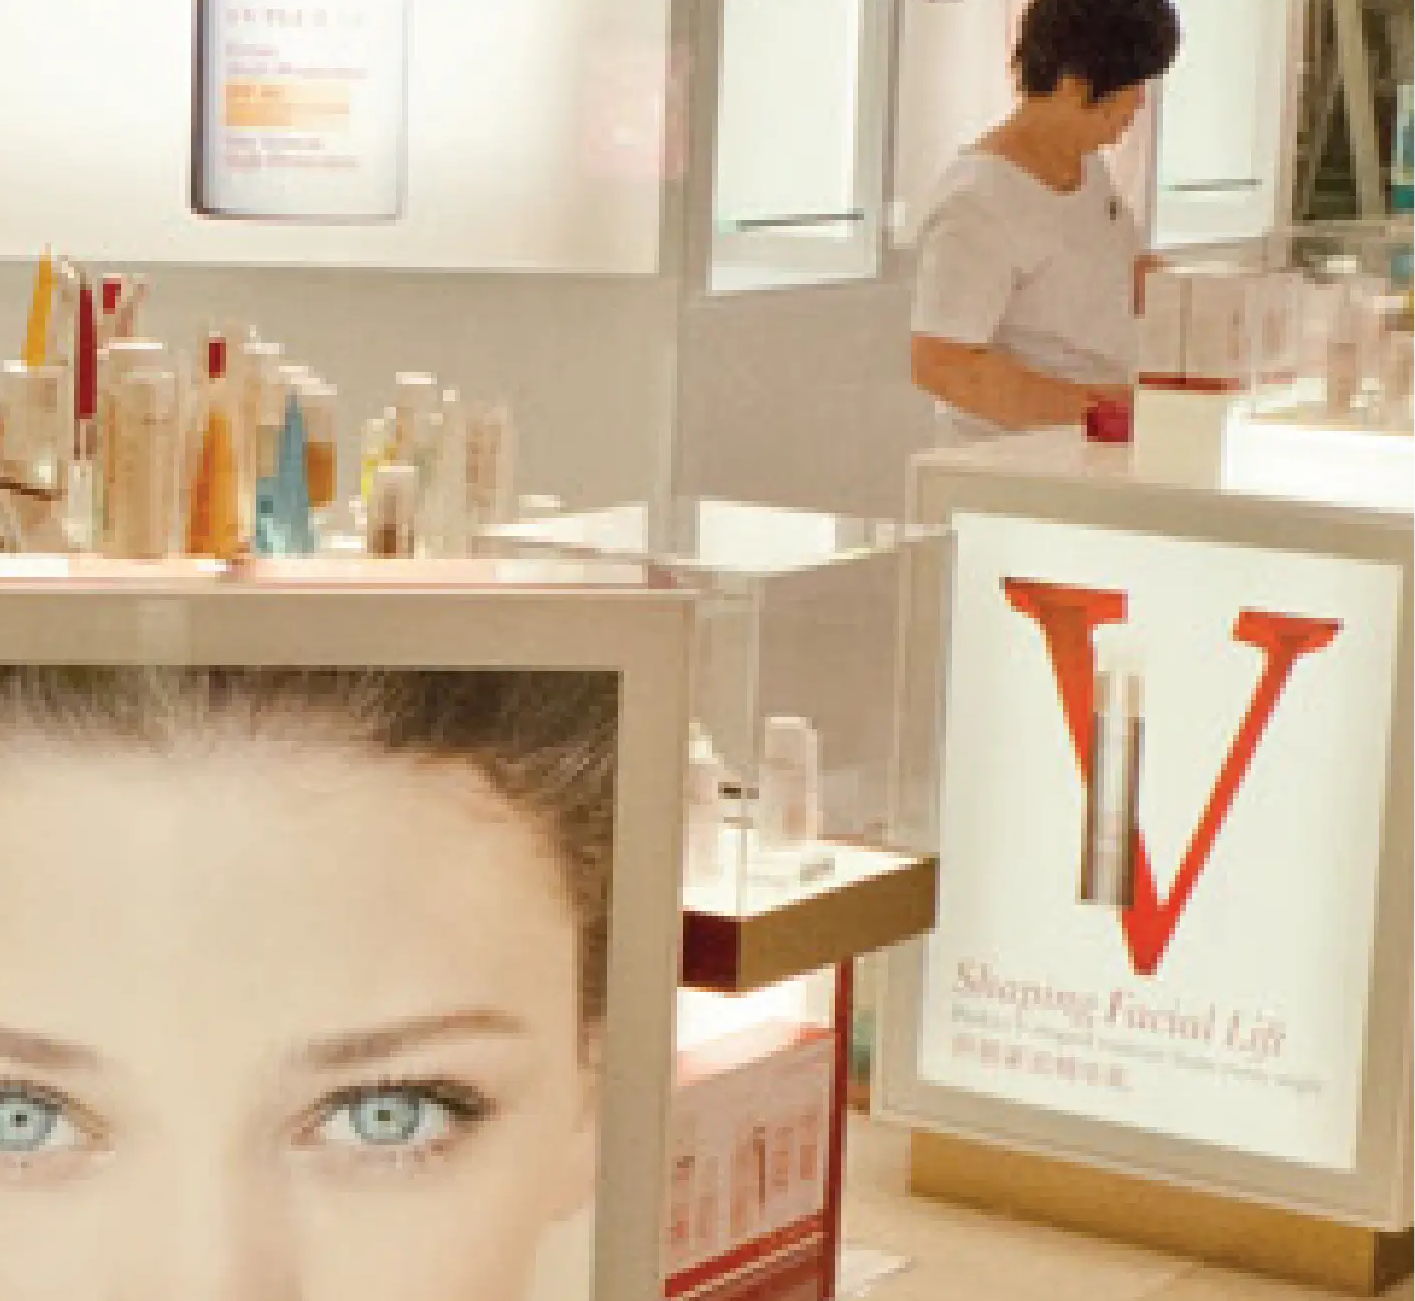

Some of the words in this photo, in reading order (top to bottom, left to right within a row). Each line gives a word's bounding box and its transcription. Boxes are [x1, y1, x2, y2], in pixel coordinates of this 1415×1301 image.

[998, 575, 1345, 976] V
[951, 958, 1099, 1032] Shaping
[1103, 987, 1216, 1040] Facial
[1224, 1008, 1287, 1059] Lift
